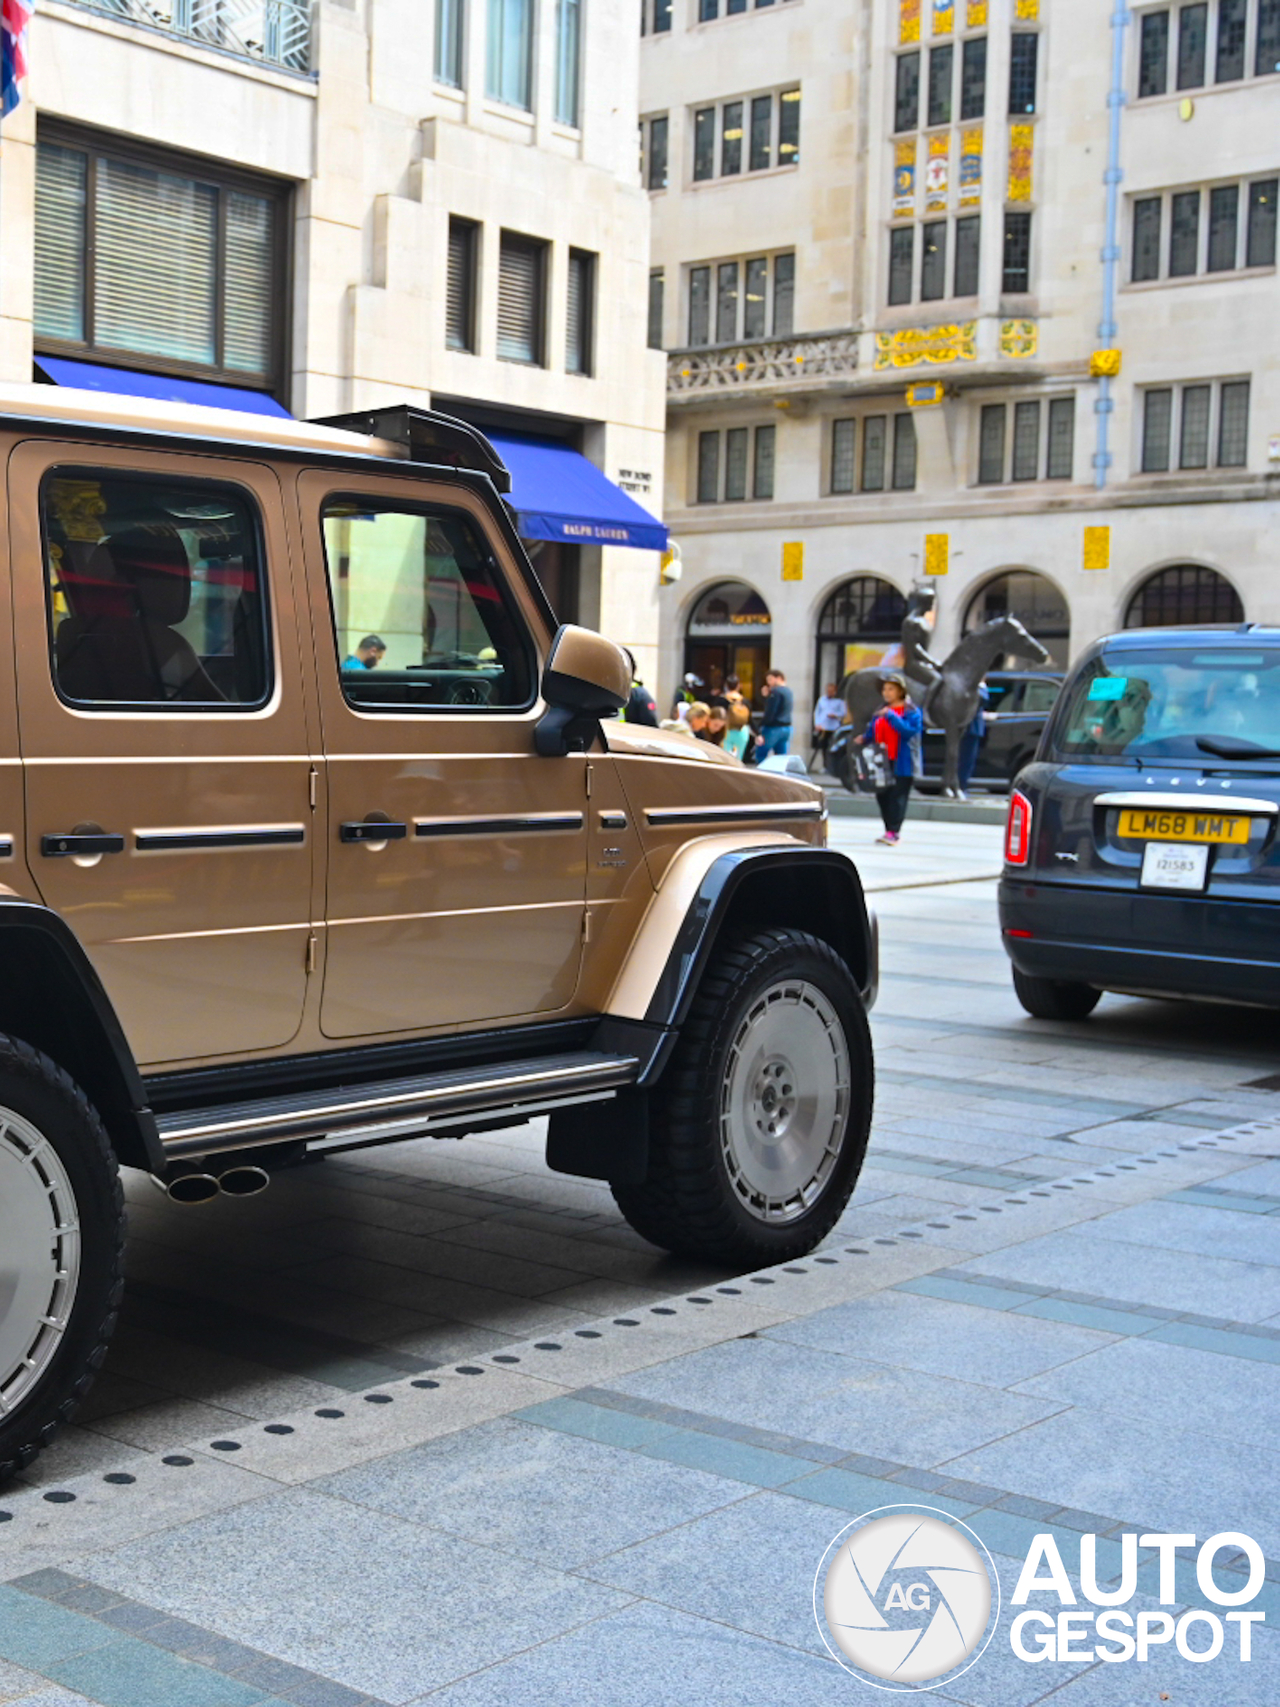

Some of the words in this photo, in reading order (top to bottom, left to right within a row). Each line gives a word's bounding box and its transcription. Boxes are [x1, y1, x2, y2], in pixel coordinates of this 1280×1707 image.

[563, 524, 592, 537] RALPH
[594, 526, 629, 540] LAUREN
[1128, 812, 1187, 836] LM68
[1192, 816, 1239, 838] WMT
[1156, 859, 1195, 871] 121583
